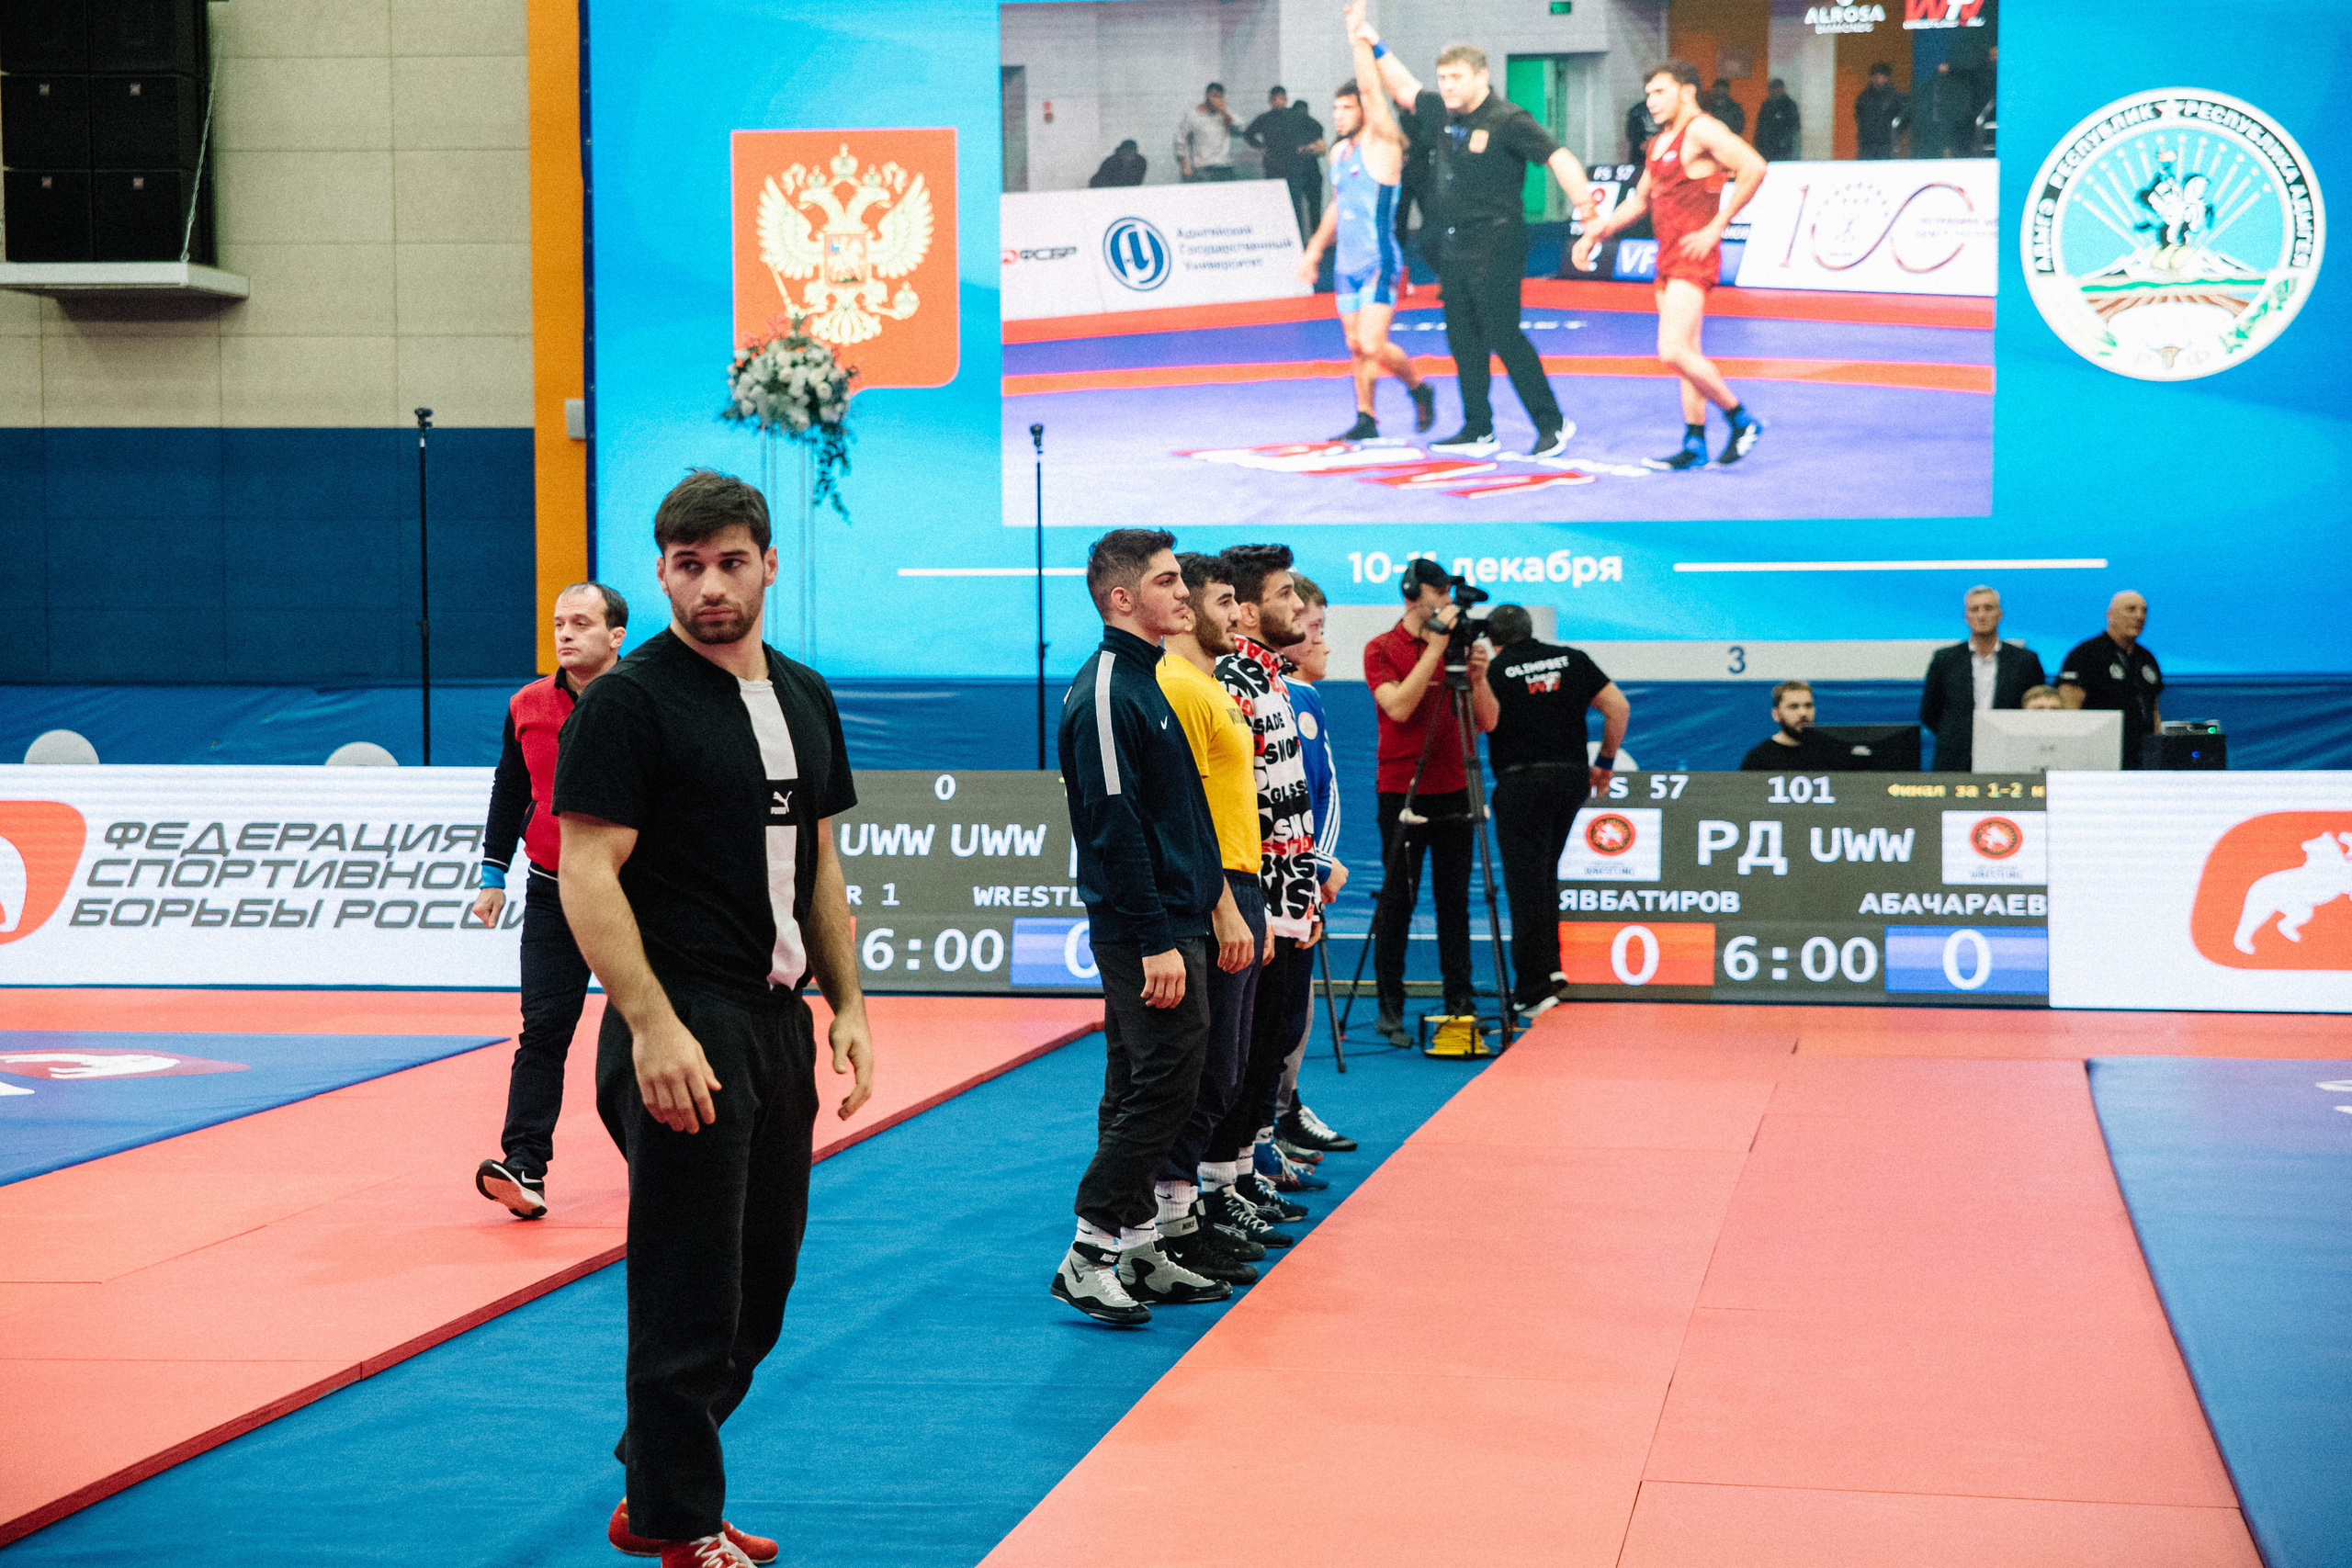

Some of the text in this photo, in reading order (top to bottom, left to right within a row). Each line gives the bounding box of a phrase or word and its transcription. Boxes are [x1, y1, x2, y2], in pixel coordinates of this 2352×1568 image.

[1804, 5, 1886, 25] ALROSA
[2184, 99, 2301, 185] РЕСПУБЛИКА
[1348, 549, 1623, 588] 10- декабря
[1728, 646, 1746, 674] 3
[934, 774, 956, 800] 0
[1650, 774, 1690, 799] 57
[1768, 776, 1836, 804] 101
[1887, 783, 1946, 798] Финал
[1954, 784, 1979, 798] за
[1987, 782, 2023, 798] 1-2
[105, 821, 487, 858] ФЕДЕРАЦИЯ
[840, 823, 935, 856] UWW
[950, 824, 1046, 857] UWW
[1697, 819, 1789, 876] РД
[1809, 827, 1916, 863] UWW
[881, 883, 900, 906] 1
[973, 886, 1086, 908] WRESTL
[1558, 888, 1741, 913] ЯВБАТИРОВ
[1858, 892, 2048, 917] АБАЧАРАЕВ
[70, 898, 322, 929] БОРЬБЫ
[862, 928, 1004, 972] 6:00
[1611, 924, 1660, 987] 0
[1723, 935, 1879, 982] 6:00
[1941, 928, 1993, 990] 0
